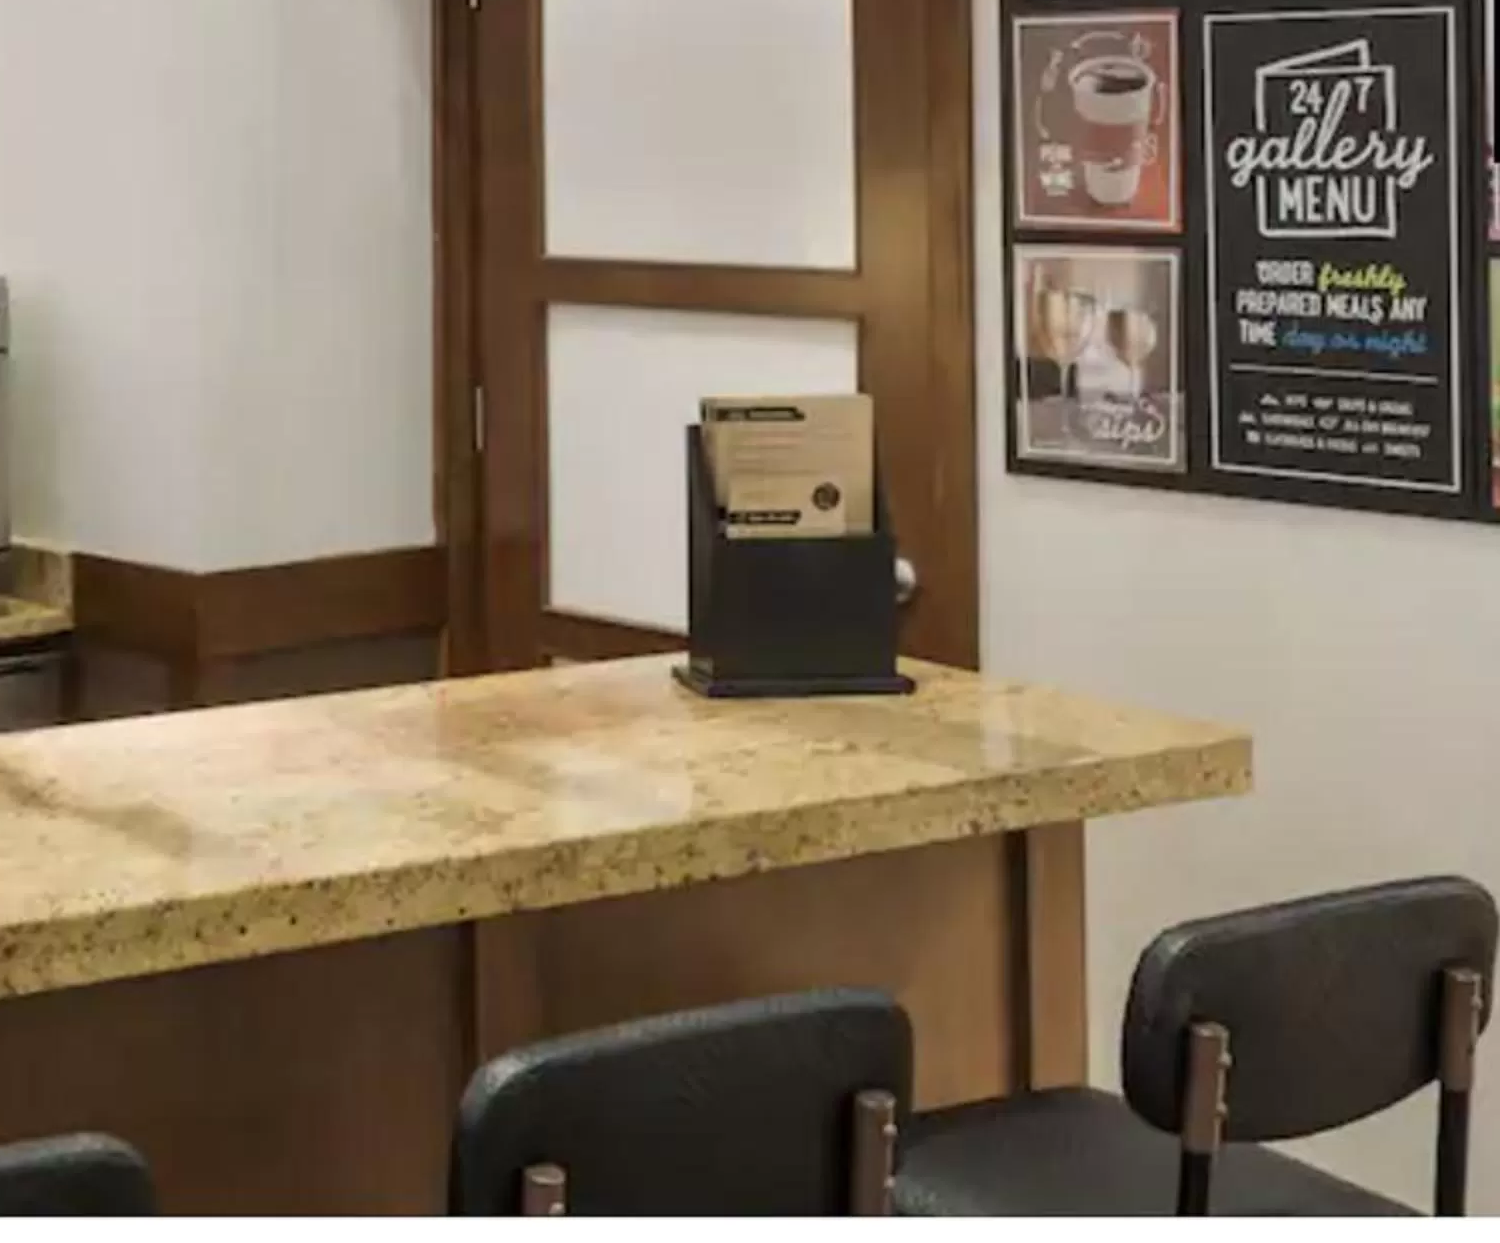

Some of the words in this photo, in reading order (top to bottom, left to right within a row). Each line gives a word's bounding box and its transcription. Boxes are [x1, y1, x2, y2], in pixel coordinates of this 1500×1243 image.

[1226, 79, 1434, 189] gallery
[1278, 175, 1376, 223] MENU
[1256, 260, 1314, 286] ORDER
[1317, 261, 1407, 295] freshly
[1236, 289, 1322, 317] PREPARED
[1326, 294, 1384, 325] MEALS
[1389, 296, 1428, 322] ANY
[1239, 319, 1277, 346] TIME
